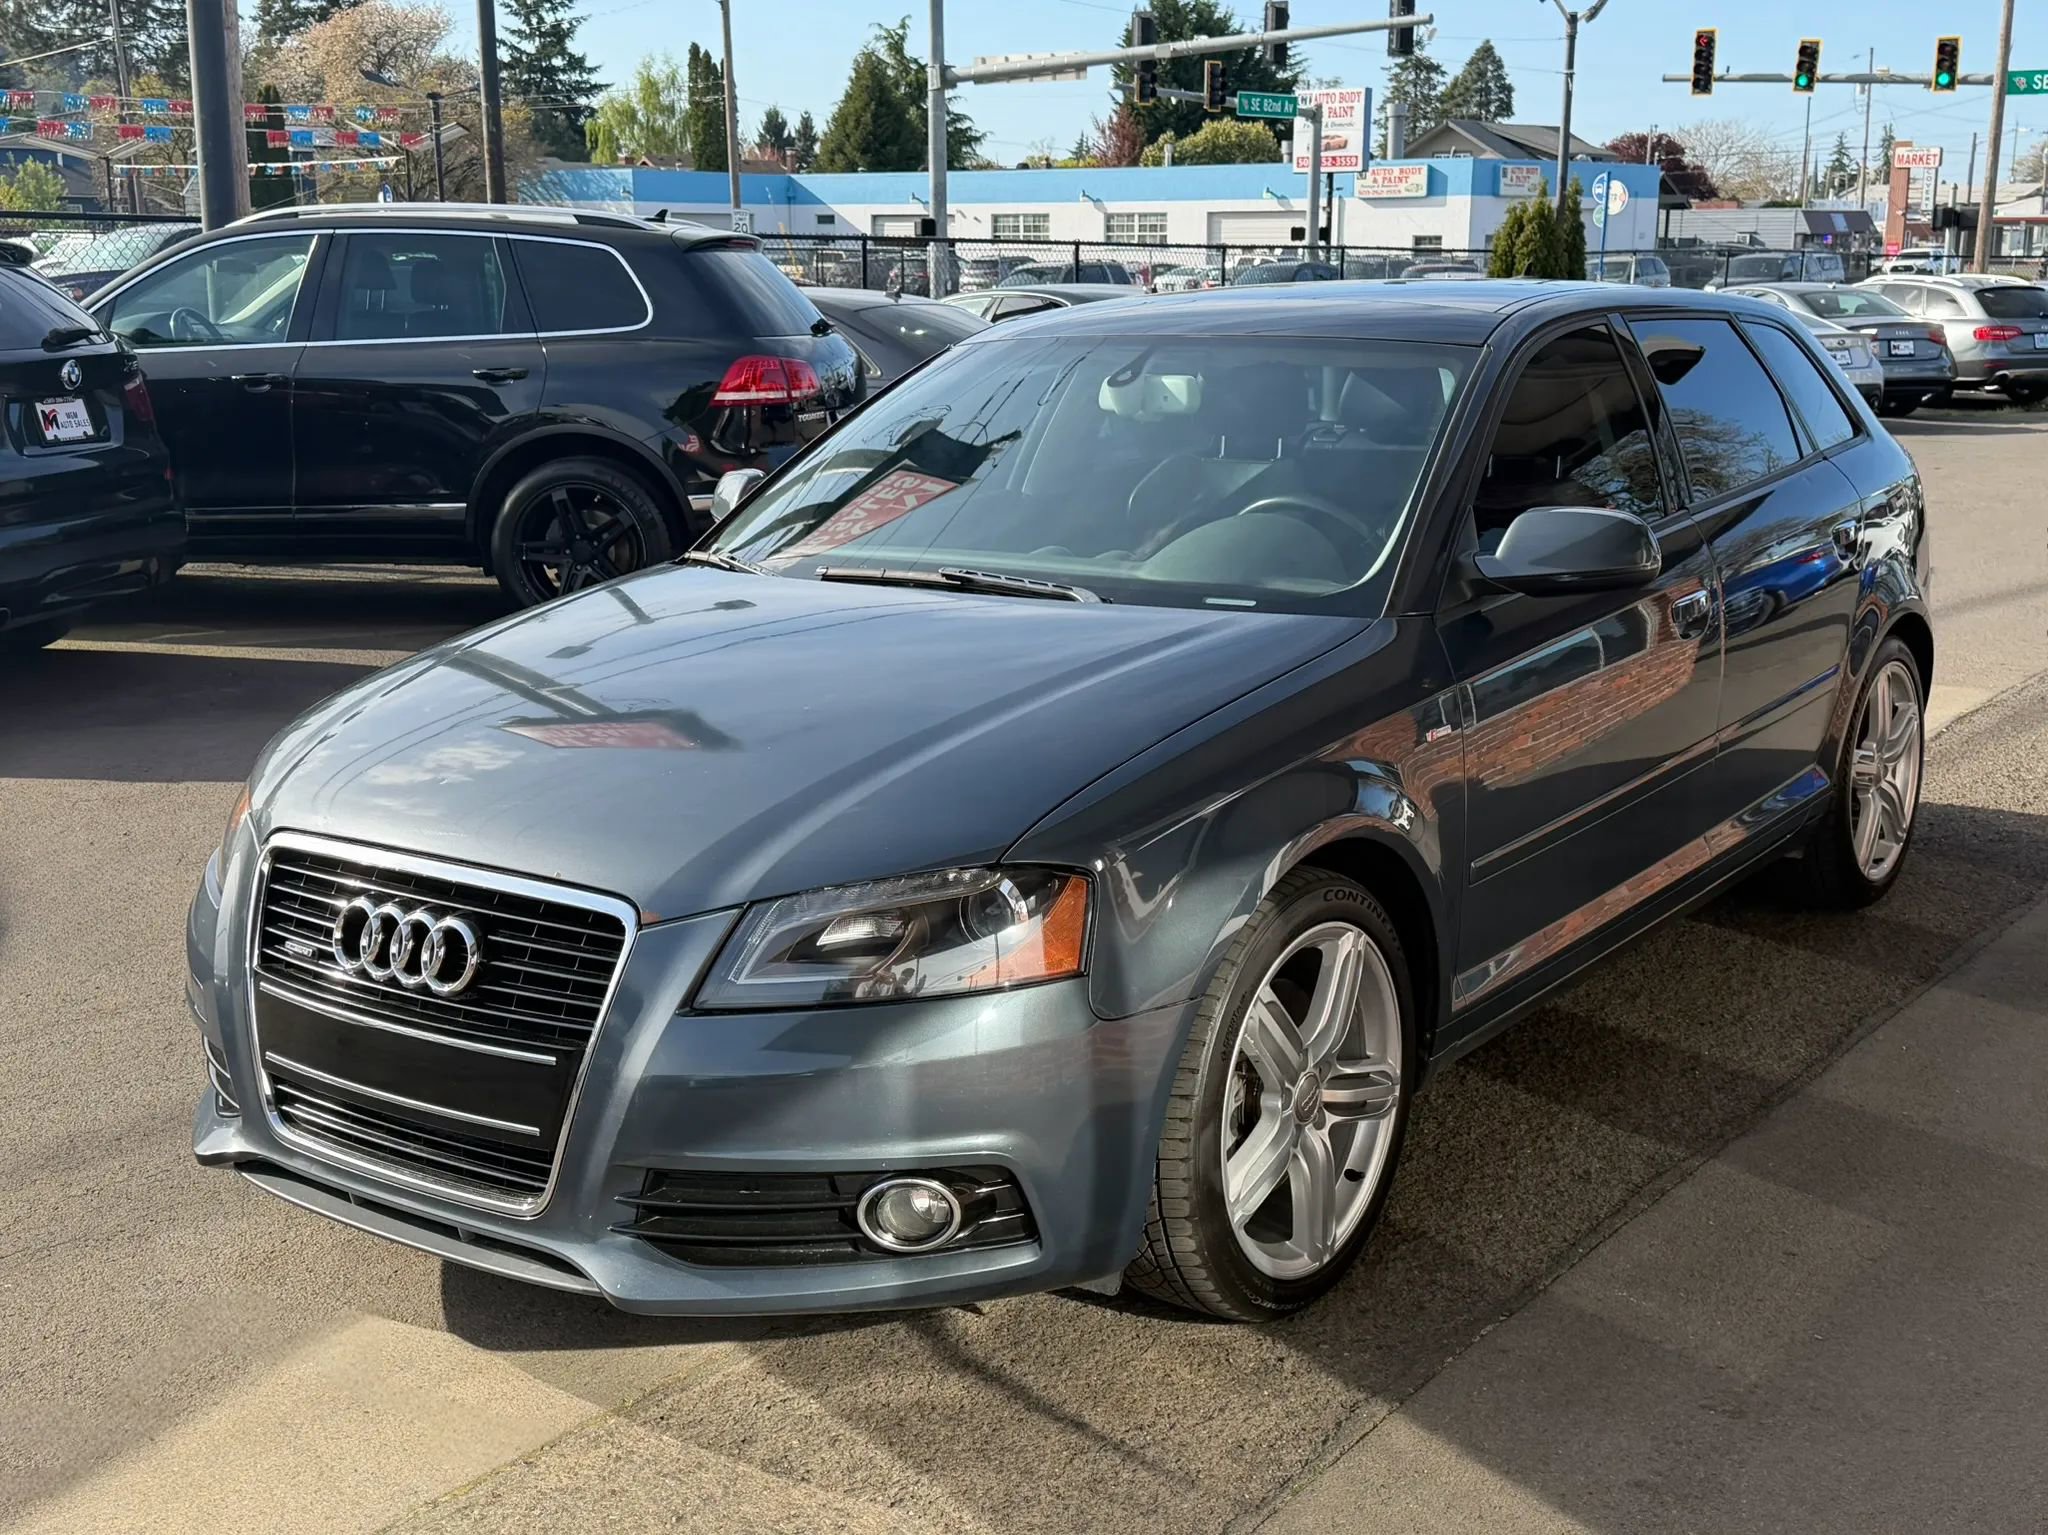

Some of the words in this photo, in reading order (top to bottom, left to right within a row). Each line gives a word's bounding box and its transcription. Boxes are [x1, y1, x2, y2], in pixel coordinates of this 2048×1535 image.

[1315, 93, 1337, 104] AUTO
[1339, 91, 1362, 104] BODY
[1251, 97, 1260, 111] SE
[1263, 98, 1282, 113] 82nd
[1284, 100, 1294, 113] Av
[1328, 106, 1354, 118] PAINT
[1896, 153, 1938, 166] MARKET
[1371, 168, 1394, 176] AUTO
[1398, 167, 1424, 175] BODY
[1382, 176, 1410, 184] PAINT
[734, 222, 748, 234] 20
[60, 420, 74, 429] AUTO
[74, 418, 91, 428] SALES
